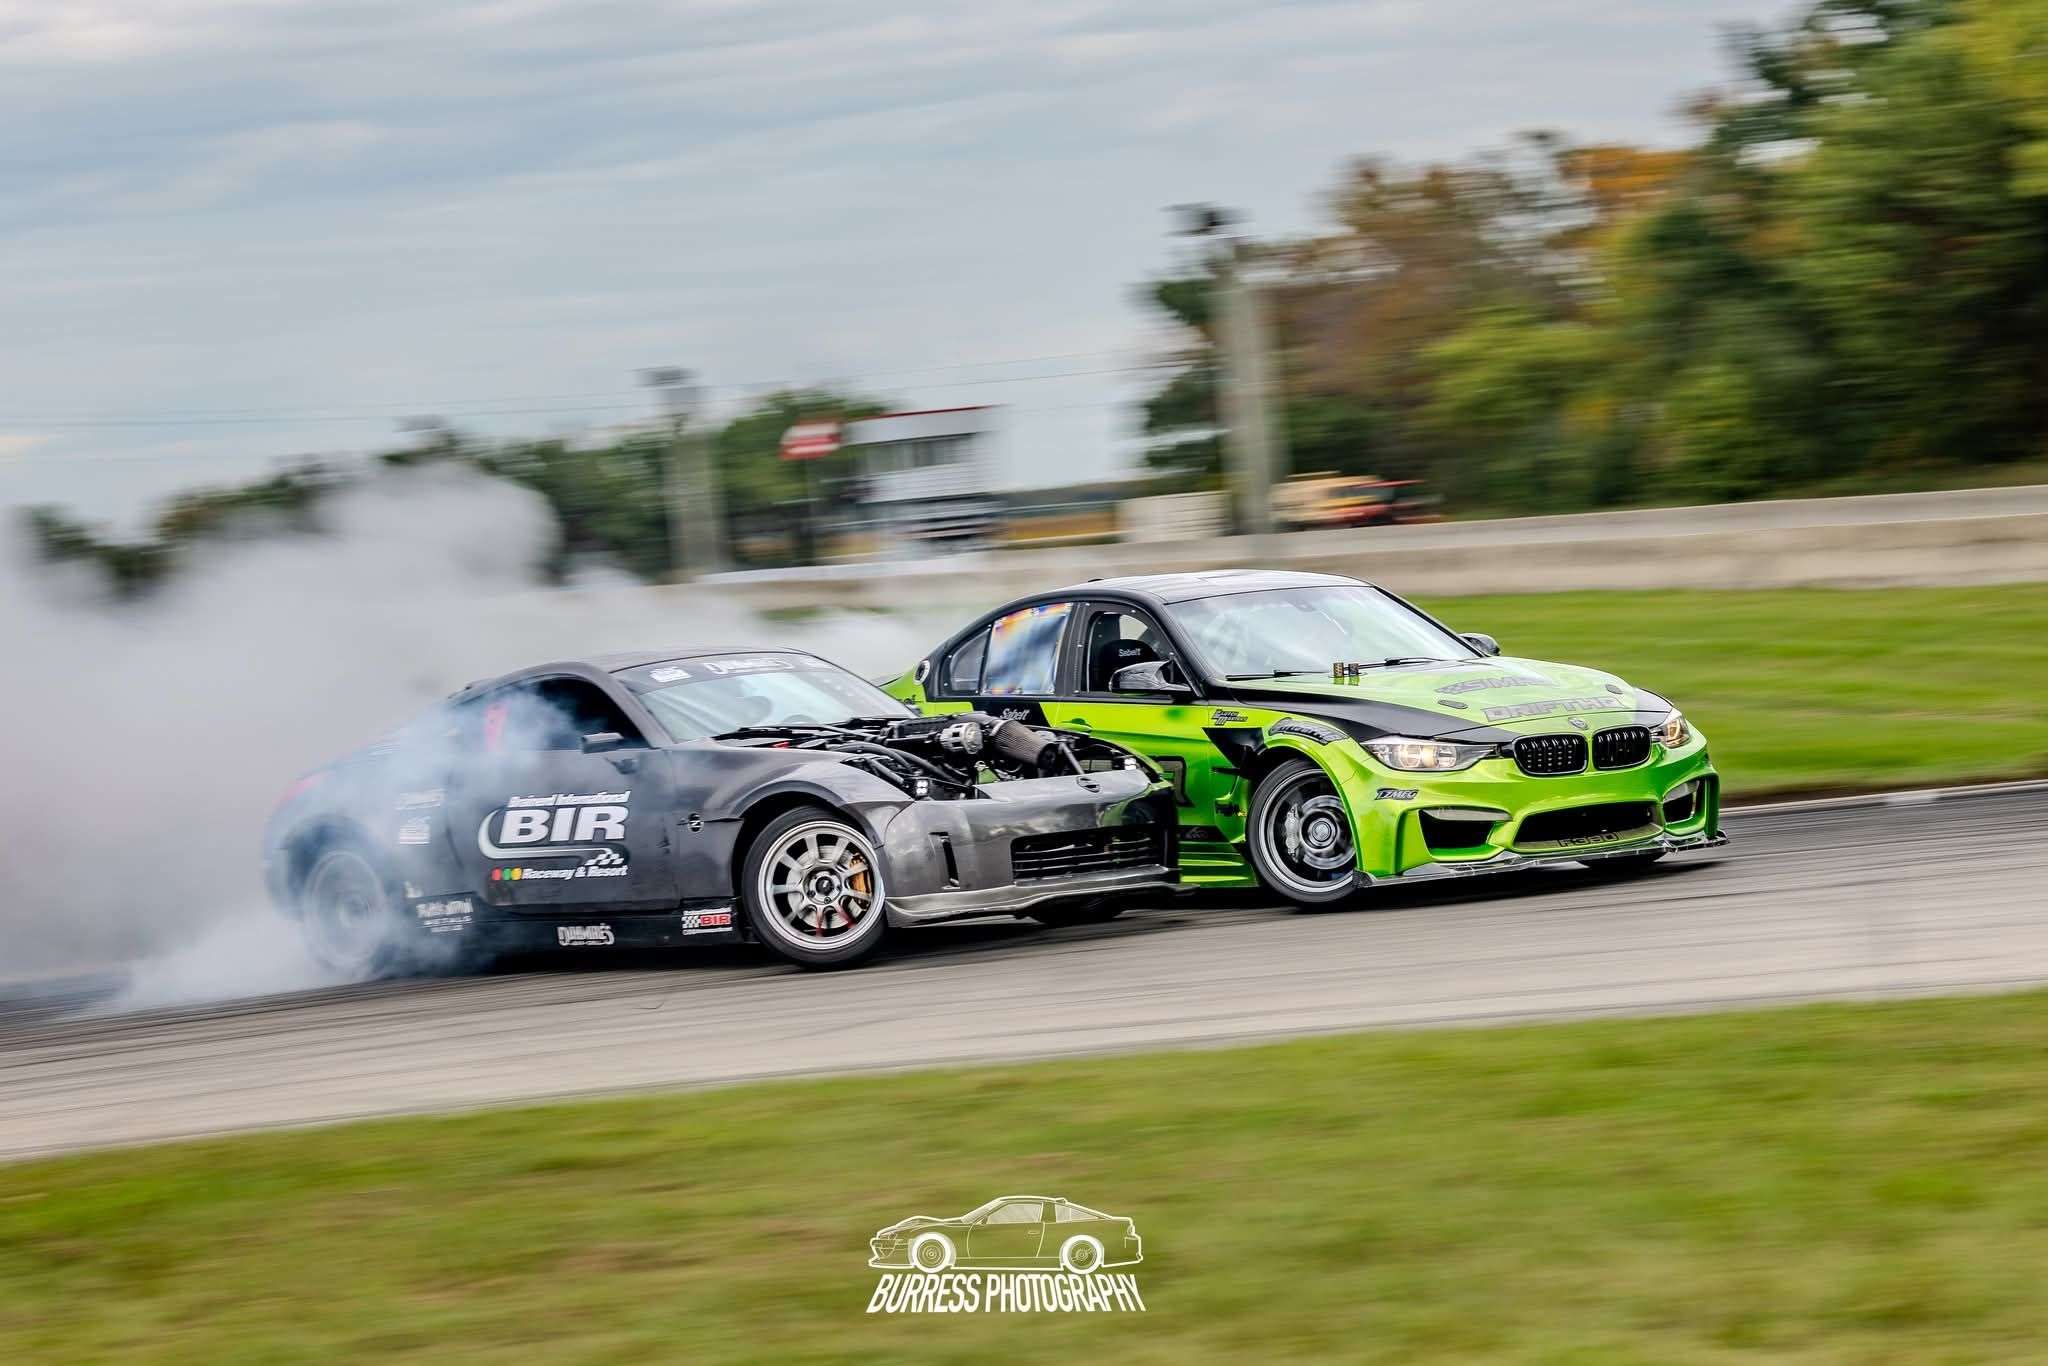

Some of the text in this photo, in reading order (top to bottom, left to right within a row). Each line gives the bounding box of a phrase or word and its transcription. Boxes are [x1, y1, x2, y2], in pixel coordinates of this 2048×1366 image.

[498, 806, 629, 844] BIR
[522, 864, 628, 881] Raceway & Resort
[701, 915, 730, 925] BIR
